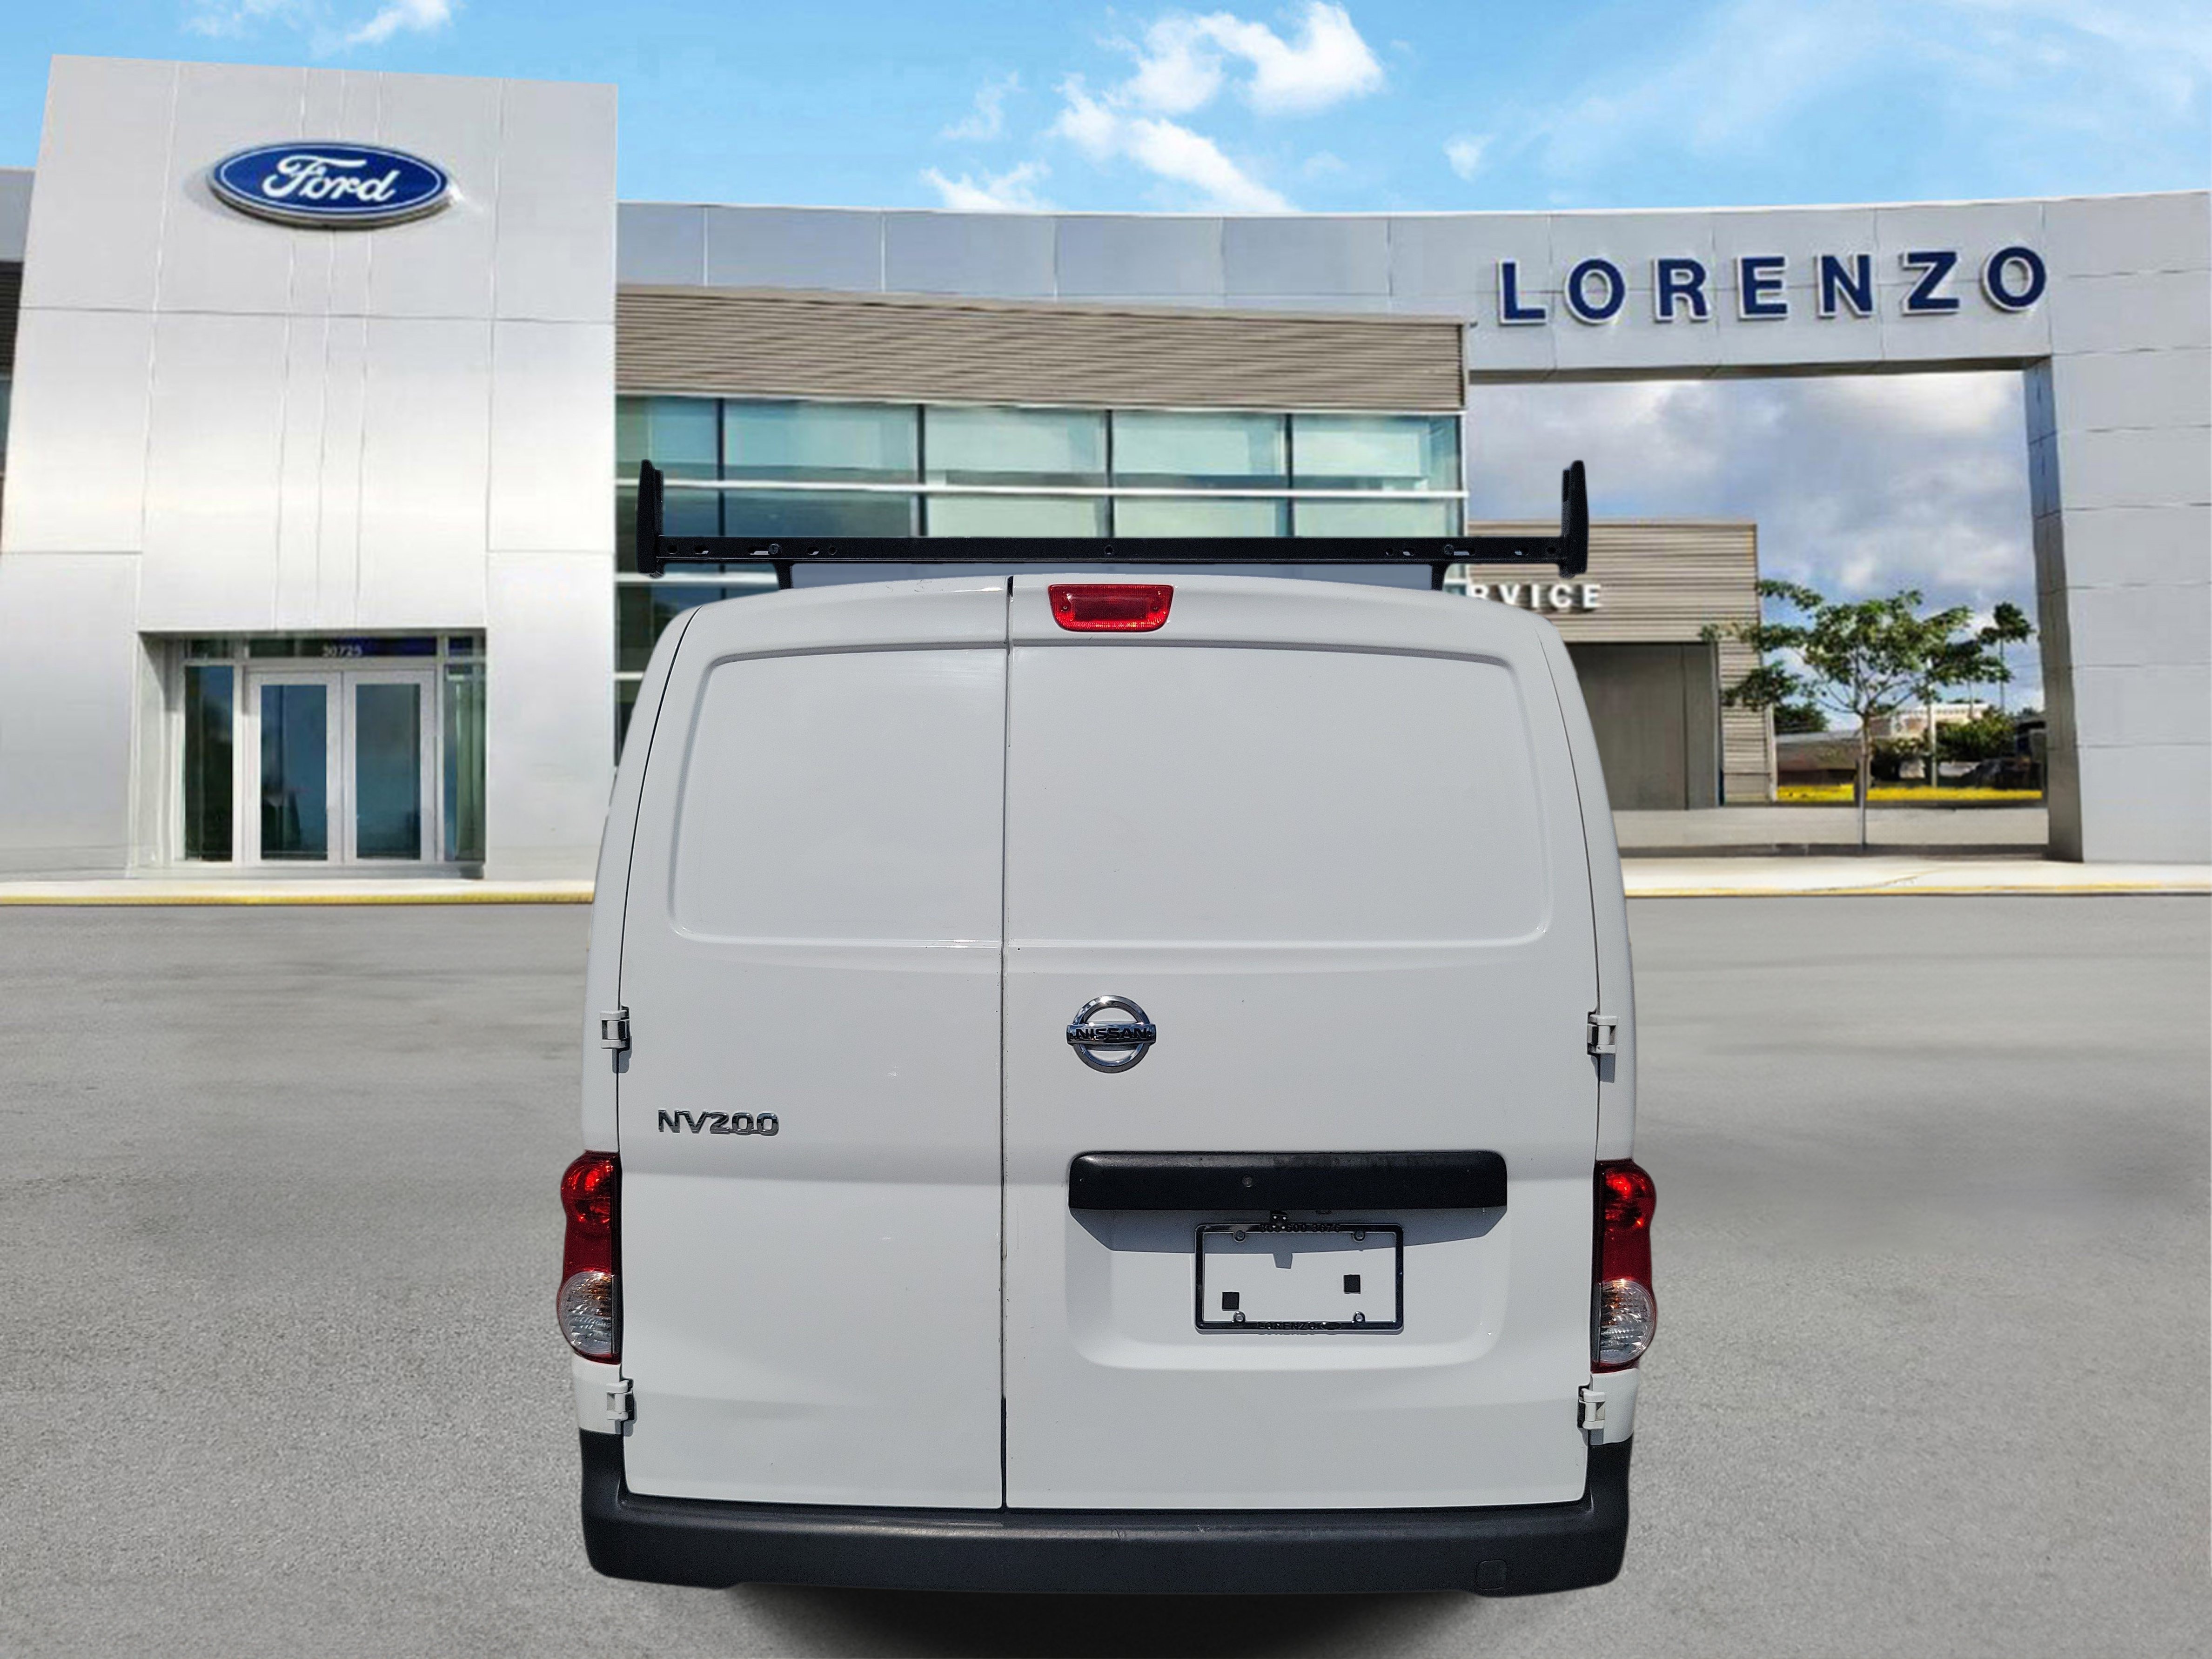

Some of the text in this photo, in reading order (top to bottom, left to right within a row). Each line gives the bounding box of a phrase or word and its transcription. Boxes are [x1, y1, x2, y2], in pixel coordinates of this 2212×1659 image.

[262, 154, 400, 201] Ford
[1497, 245, 2048, 324] LORENZO
[1076, 1028, 1147, 1039] NISSAN
[658, 1109, 779, 1136] NV200
